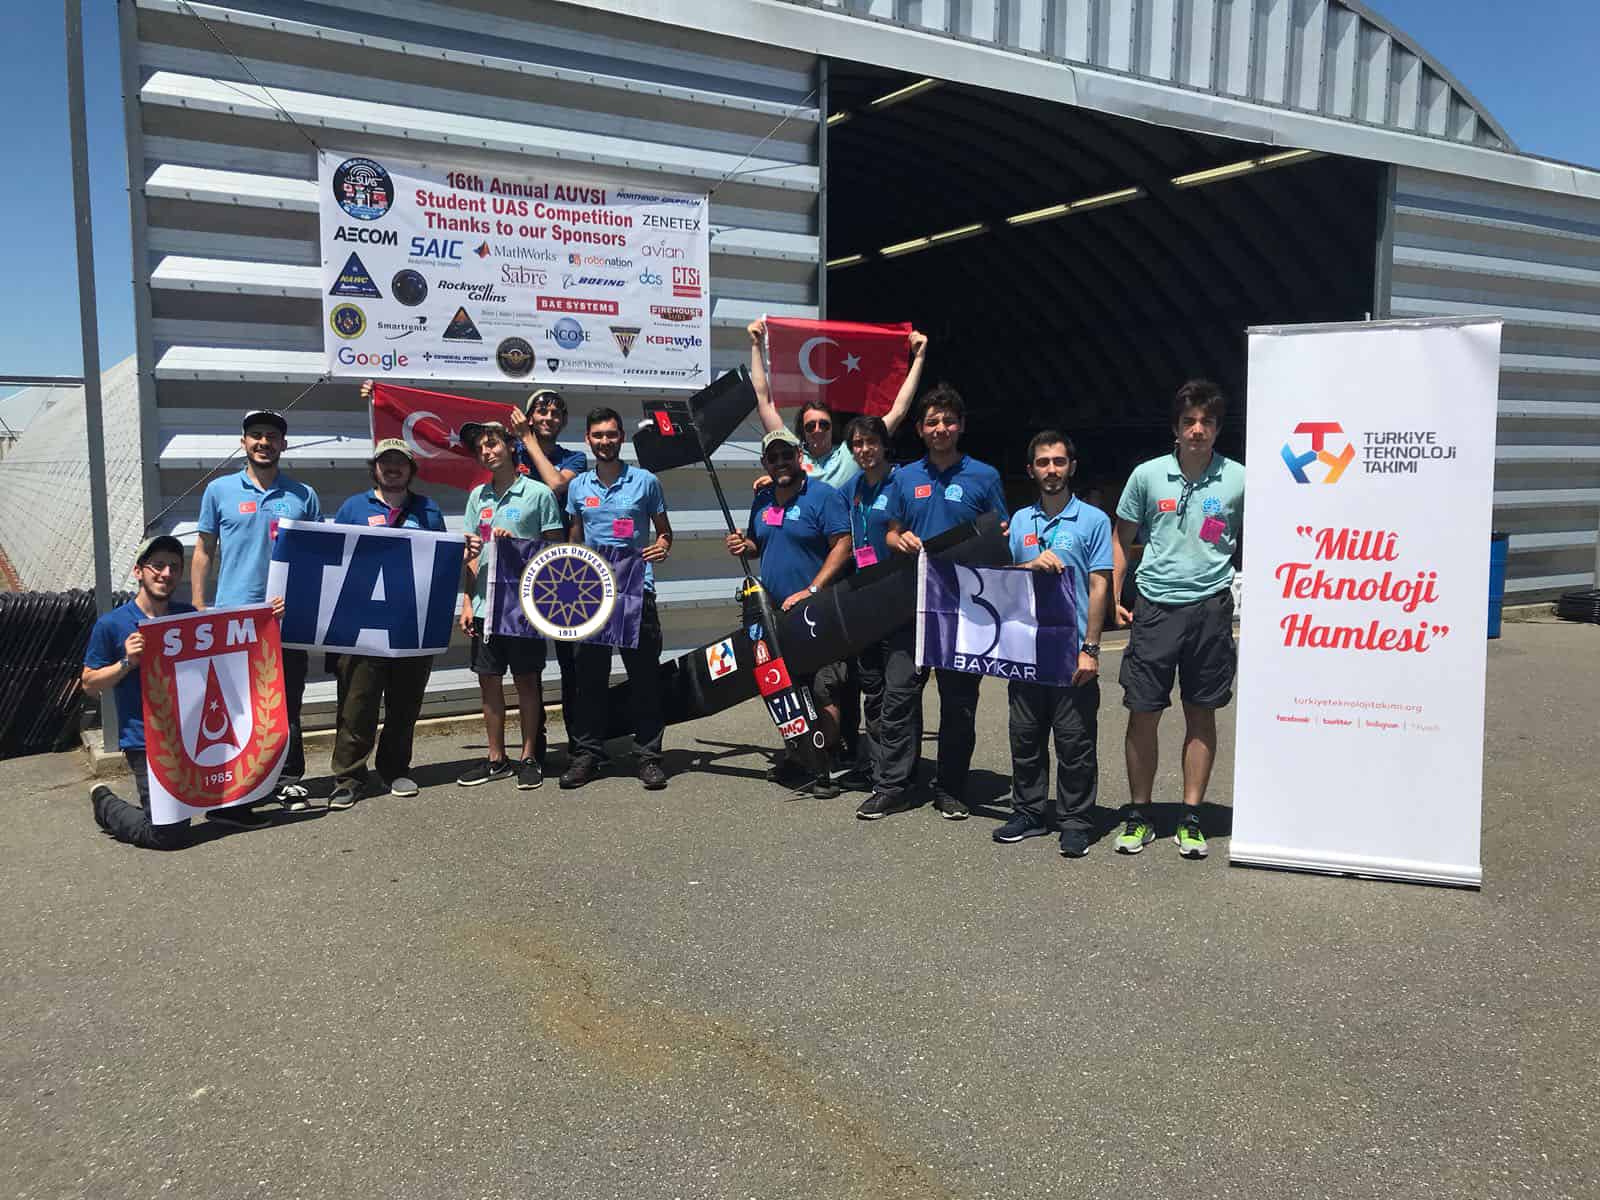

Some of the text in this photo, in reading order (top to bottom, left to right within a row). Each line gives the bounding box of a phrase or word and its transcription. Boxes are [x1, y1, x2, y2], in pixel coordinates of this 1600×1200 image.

[446, 171, 607, 206] 16th Annual AUVSI
[415, 189, 633, 228] Student UAS Competition
[424, 211, 627, 247] Thanks to our Sponsors
[642, 214, 701, 231] ZENETEX
[333, 225, 398, 247] AECOM
[408, 236, 464, 260] SAIC
[494, 245, 558, 262] MathWorks
[641, 240, 685, 259] avian
[583, 254, 633, 269] robonation
[500, 263, 548, 286] Sabre
[577, 276, 626, 288] BOEING
[639, 266, 664, 286] dcs
[672, 266, 701, 286] CTSi
[437, 279, 494, 293] Rockwell
[467, 286, 508, 303] Collins
[541, 299, 615, 314] BAE SYSTEMS
[544, 329, 591, 343] INCOSE
[338, 346, 409, 371] Google
[1363, 460, 1418, 474] TAKIMI
[522, 568, 536, 598] YILDIZ
[535, 547, 569, 568] TEKNİK
[271, 527, 467, 650] TAI
[1275, 562, 1440, 613] Teknoloji
[558, 629, 578, 637] 1911
[953, 654, 1038, 682] BAYKAR
[204, 770, 234, 787] 1985
